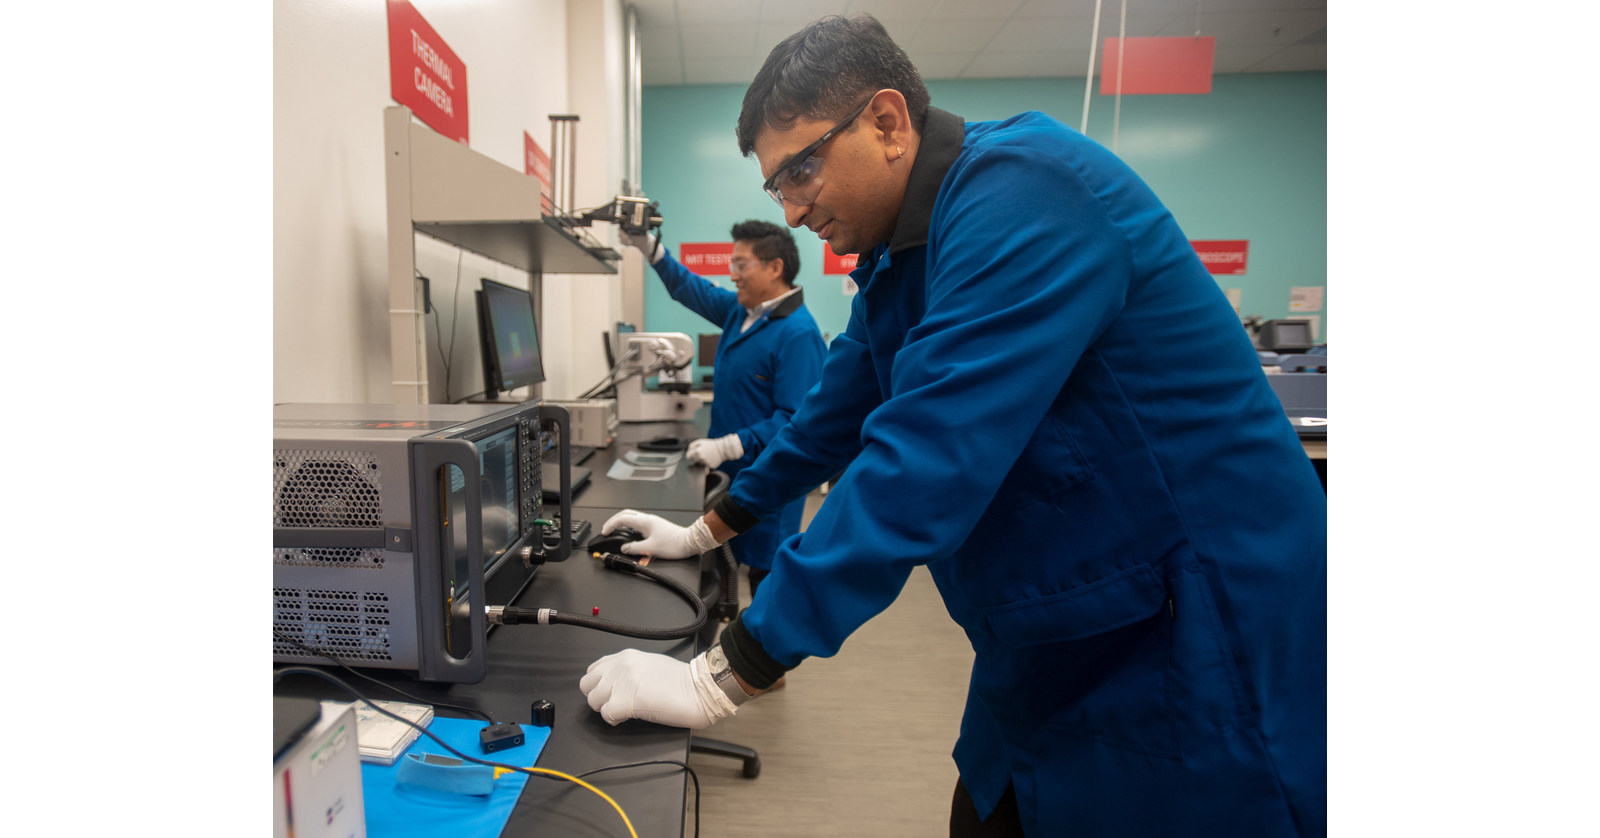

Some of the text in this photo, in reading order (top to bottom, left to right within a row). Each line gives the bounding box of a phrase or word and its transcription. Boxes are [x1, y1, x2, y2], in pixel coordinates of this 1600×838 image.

[410, 28, 454, 90] THERMAL
[414, 66, 453, 118] CAMERA
[706, 253, 733, 265] TESTE
[1198, 252, 1243, 263] ROSCOPE
